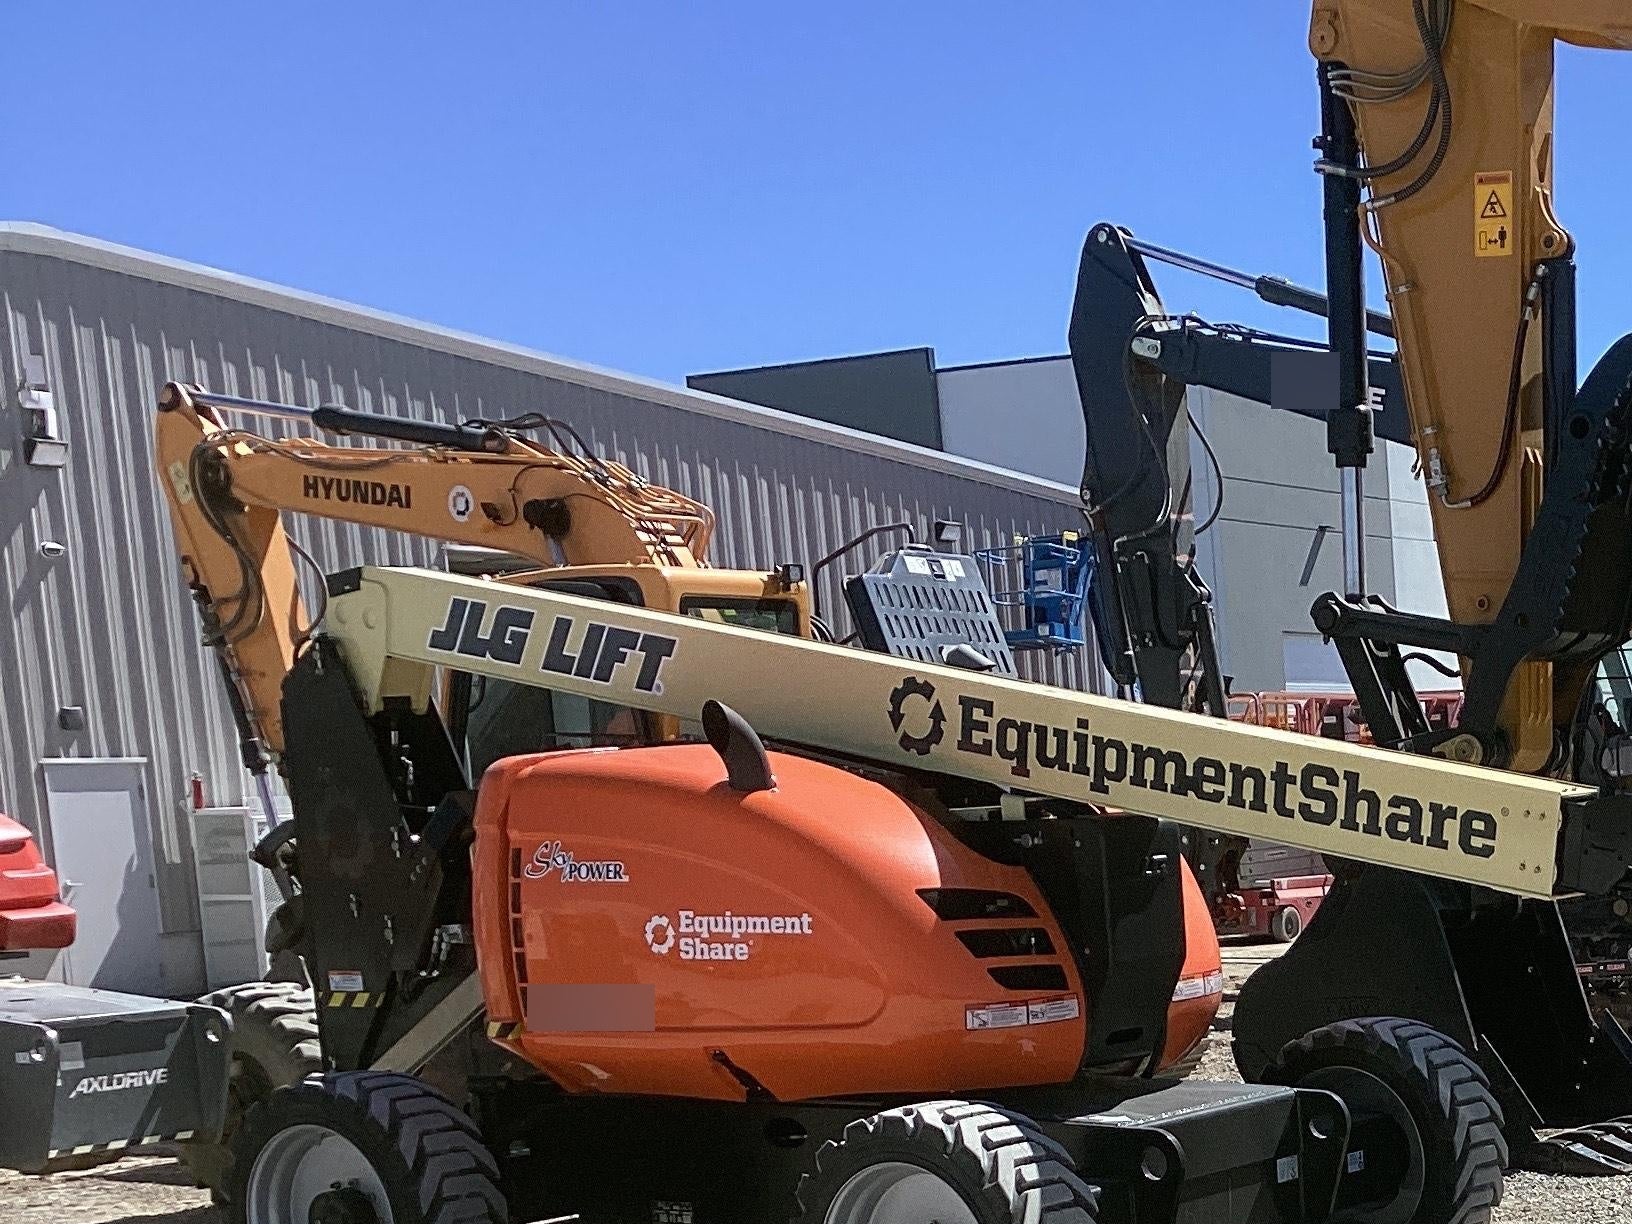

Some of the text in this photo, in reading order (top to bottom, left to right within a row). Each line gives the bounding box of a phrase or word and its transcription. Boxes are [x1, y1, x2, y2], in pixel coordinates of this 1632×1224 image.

[303, 474, 412, 509] HYUNDAI
[428, 597, 678, 693] JLG LIFT
[957, 695, 1497, 859] EquipmentShare
[678, 910, 813, 938] Equipment
[679, 938, 750, 961] Share
[68, 1067, 169, 1099] AXLDRIVE
